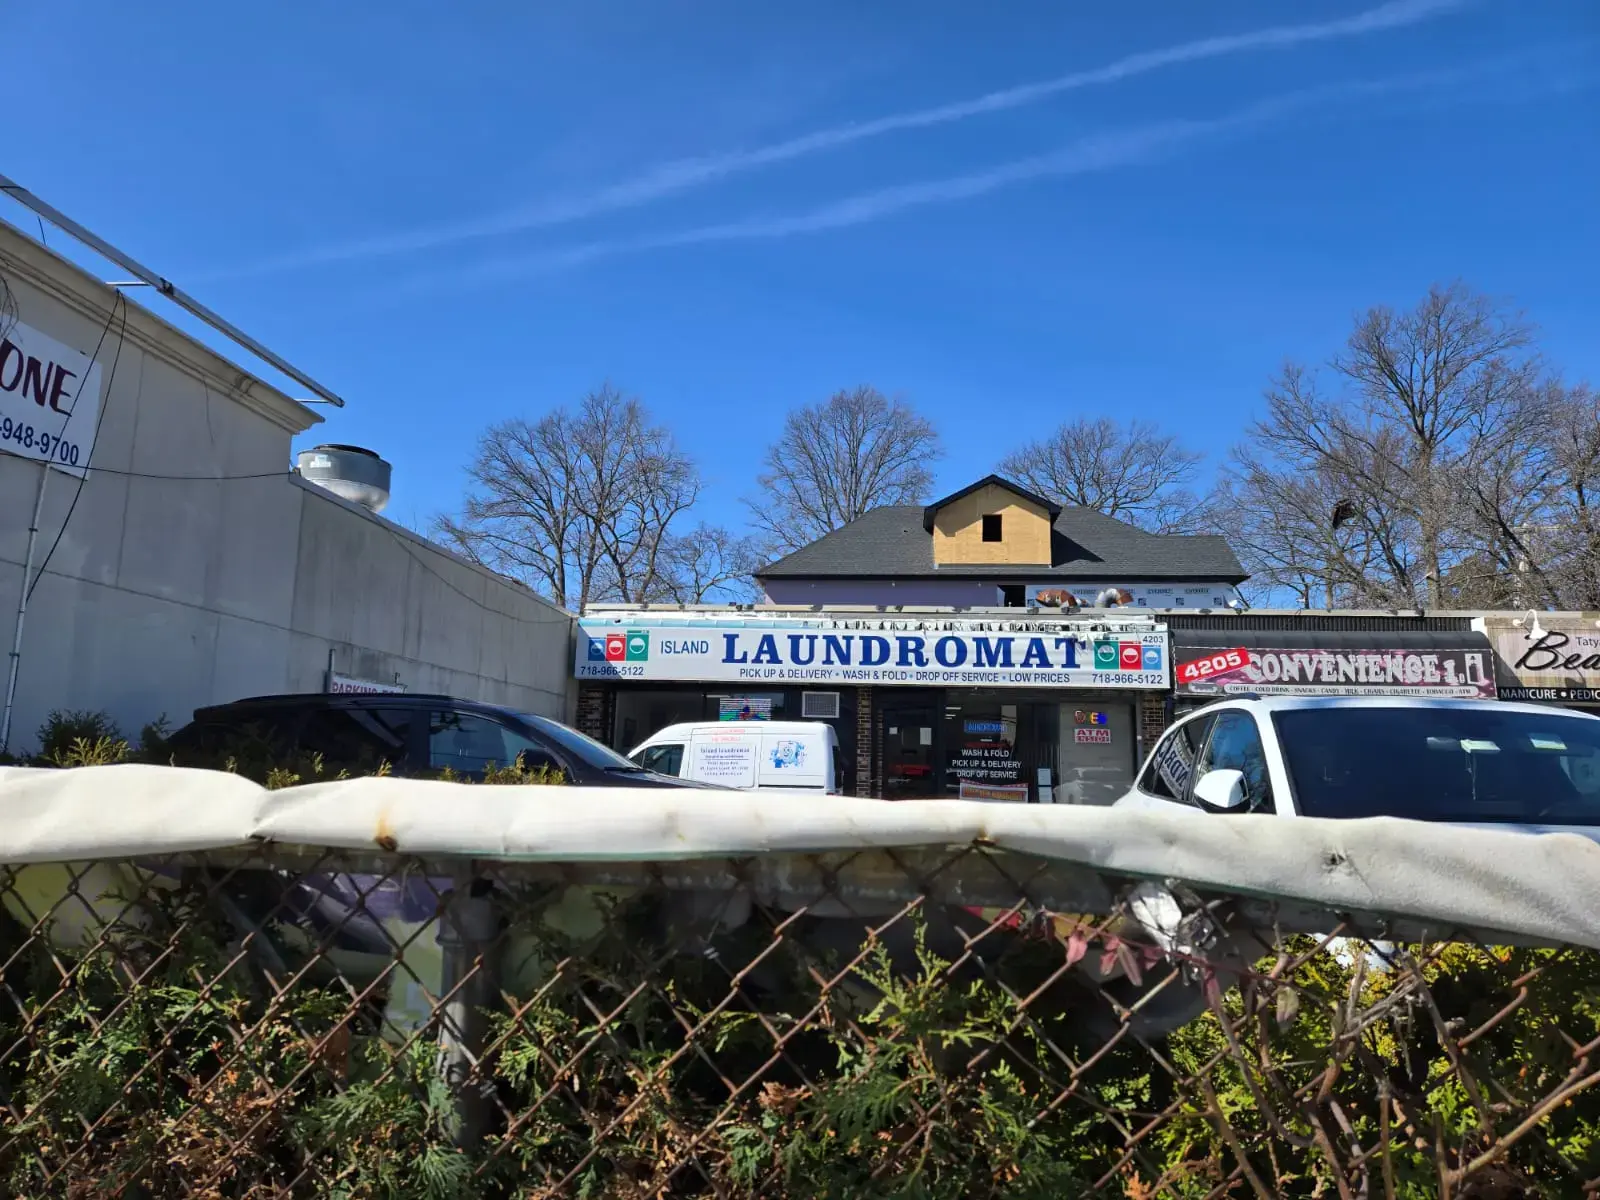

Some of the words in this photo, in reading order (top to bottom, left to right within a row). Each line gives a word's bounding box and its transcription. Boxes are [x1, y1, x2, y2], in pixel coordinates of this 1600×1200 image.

[1142, 636, 1164, 645] 4203
[1576, 637, 1600, 648] Taty
[660, 640, 709, 654] ISLAND
[721, 633, 1087, 670] LAUNDROMAT
[1184, 652, 1242, 678] 4205
[1242, 653, 1441, 684] CONVENIENCE
[580, 666, 644, 677] 718-966-5122
[739, 668, 762, 679] PICK
[764, 669, 776, 679] UP
[779, 669, 785, 679] &
[787, 669, 832, 680] DELIVERY
[842, 670, 870, 680] WASH
[873, 671, 880, 681] &
[882, 671, 908, 681] FOLD
[916, 672, 940, 682] DROP
[942, 672, 959, 682] OFF
[962, 672, 999, 683] SERVICE
[1009, 672, 1031, 683] LOW
[1034, 673, 1070, 684] PRICES
[1092, 673, 1163, 684] 718-966-5122
[1255, 685, 1270, 693] COLD
[1295, 686, 1316, 694] SNACKS
[1500, 688, 1558, 700] MANICURE
[961, 749, 983, 757] WASH
[991, 750, 1010, 758] FOLD
[952, 759, 969, 767] PICK
[988, 761, 1022, 769] DELIVERY
[976, 770, 988, 778] OFF
[990, 770, 1017, 779] SERVICE
